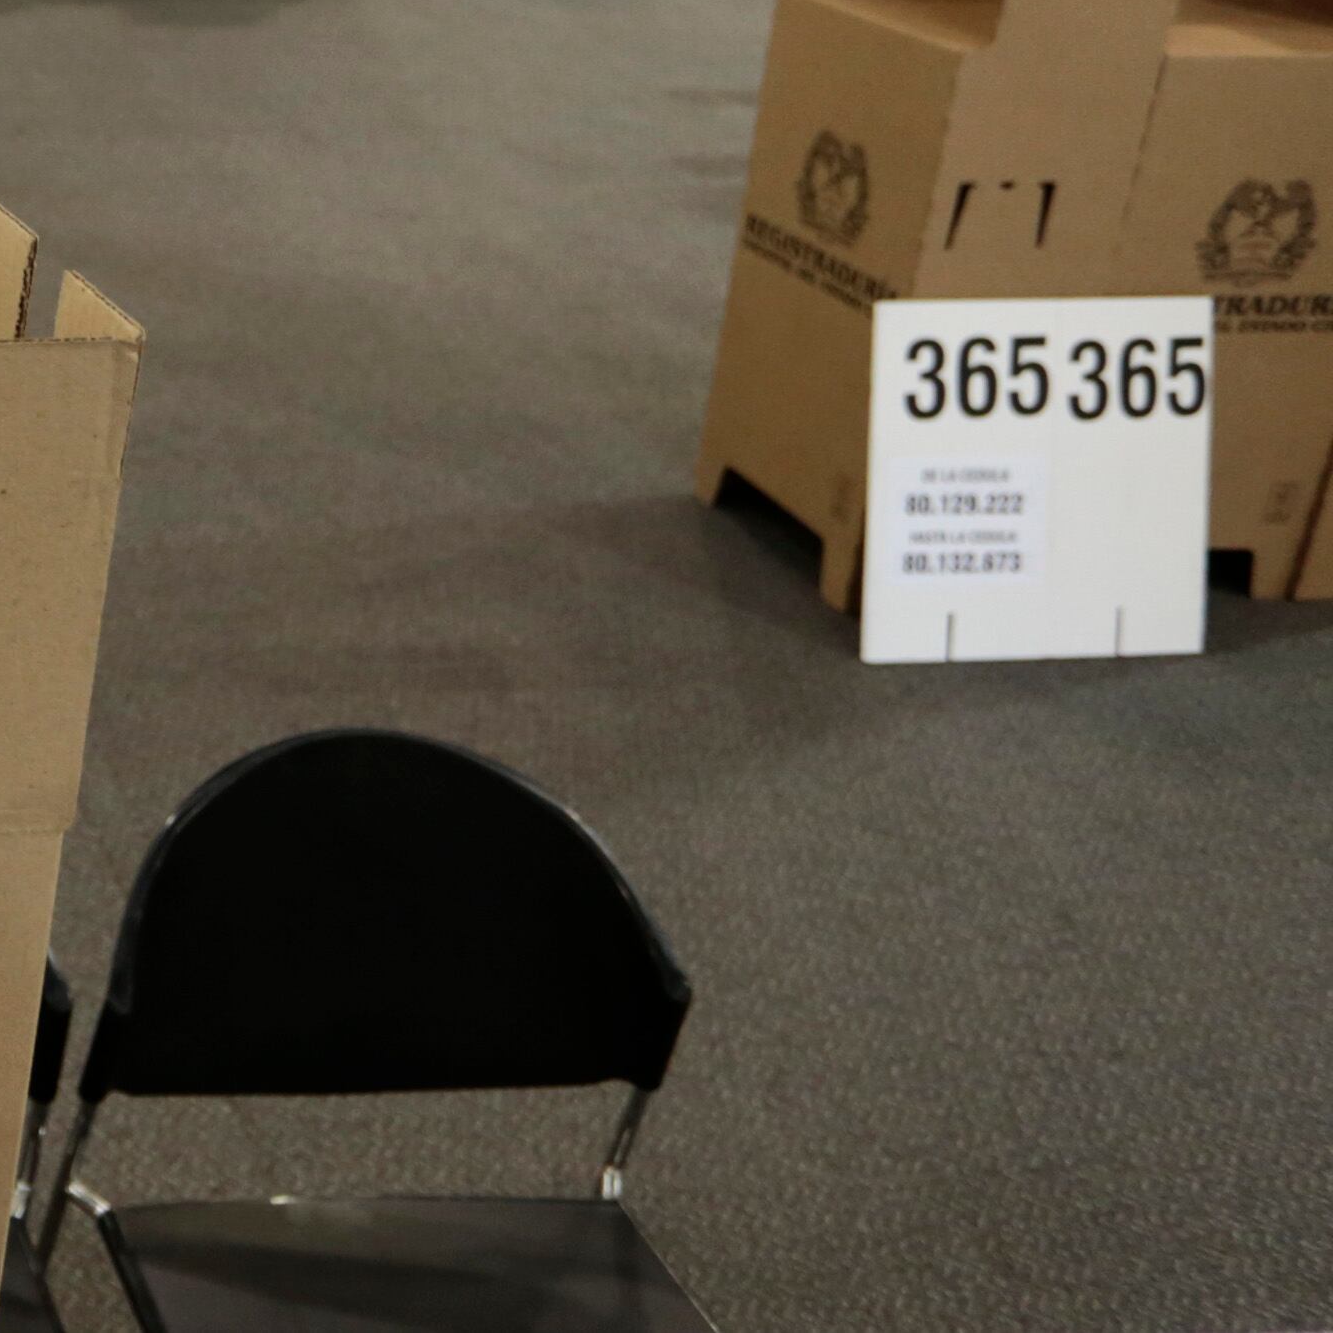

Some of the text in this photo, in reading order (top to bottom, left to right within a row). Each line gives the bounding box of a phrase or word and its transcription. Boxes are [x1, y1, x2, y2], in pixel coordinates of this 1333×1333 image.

[904, 336, 1206, 421] 365 365
[905, 492, 1024, 515] 80.129.222
